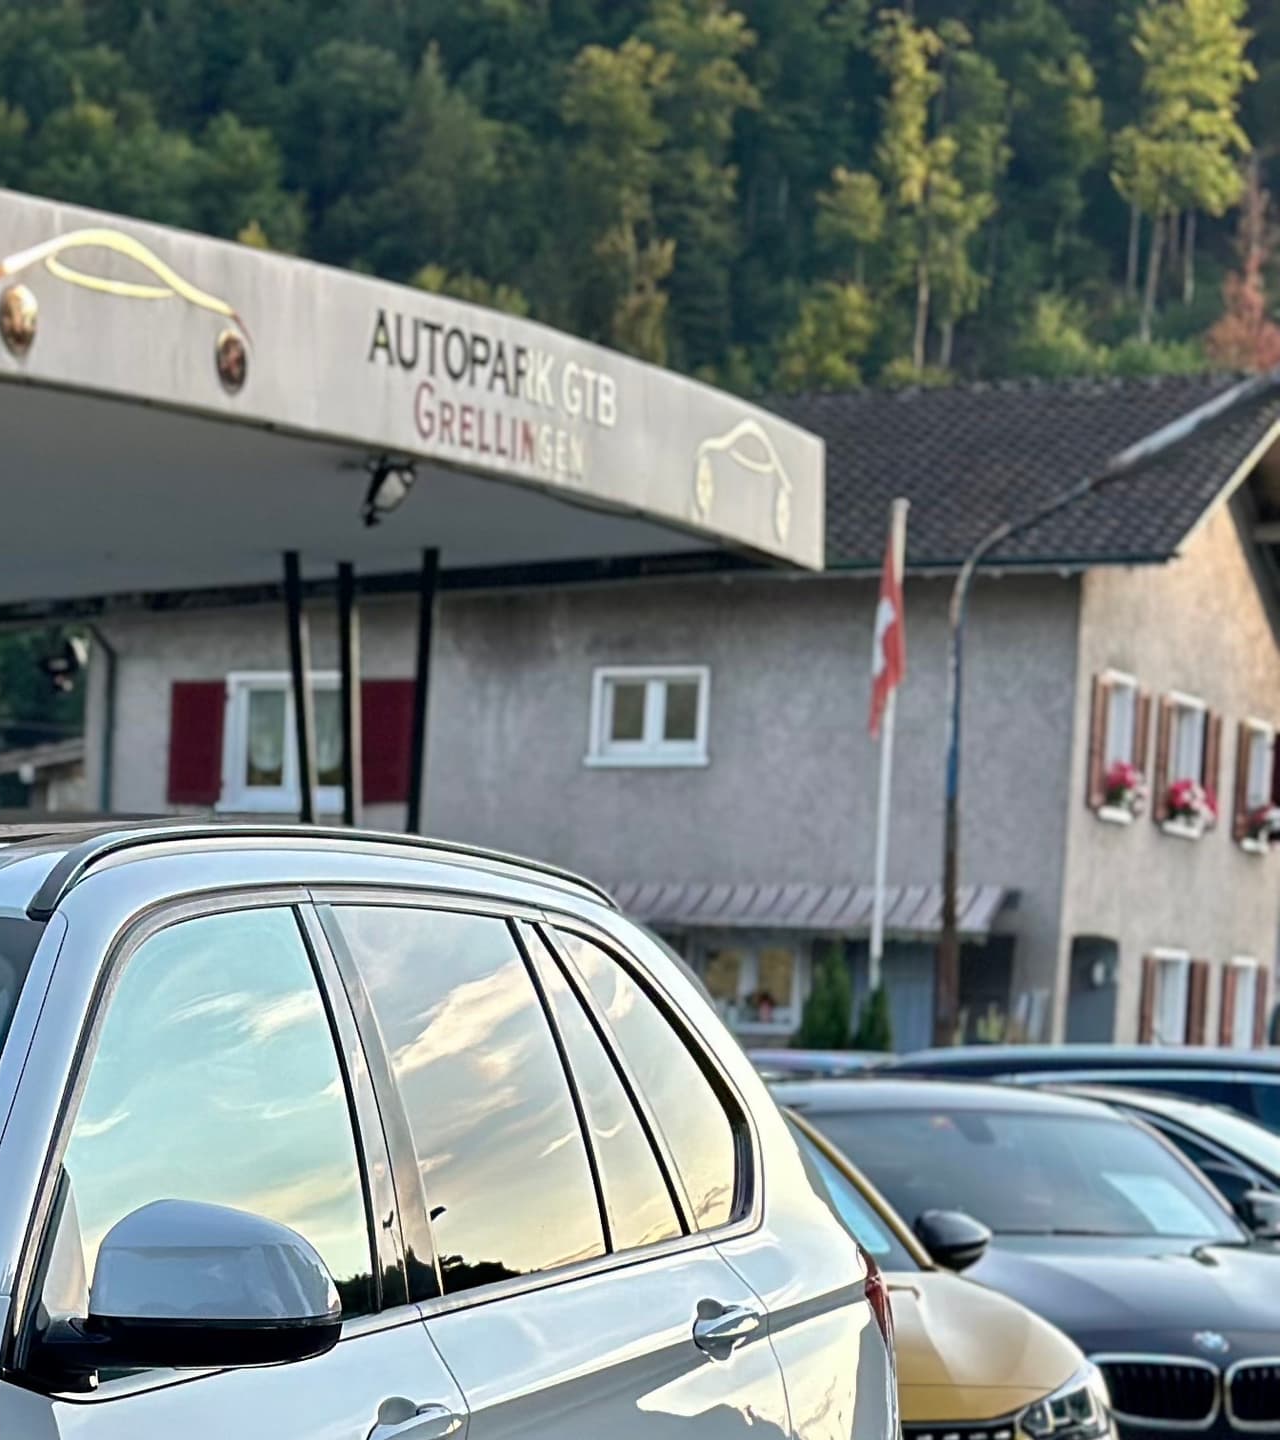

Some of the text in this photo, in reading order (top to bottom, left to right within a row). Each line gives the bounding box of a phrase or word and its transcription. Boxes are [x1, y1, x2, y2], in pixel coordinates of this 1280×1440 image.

[368, 308, 617, 428] AUTOPARK GTB
[414, 380, 585, 478] GRELLINGEN
